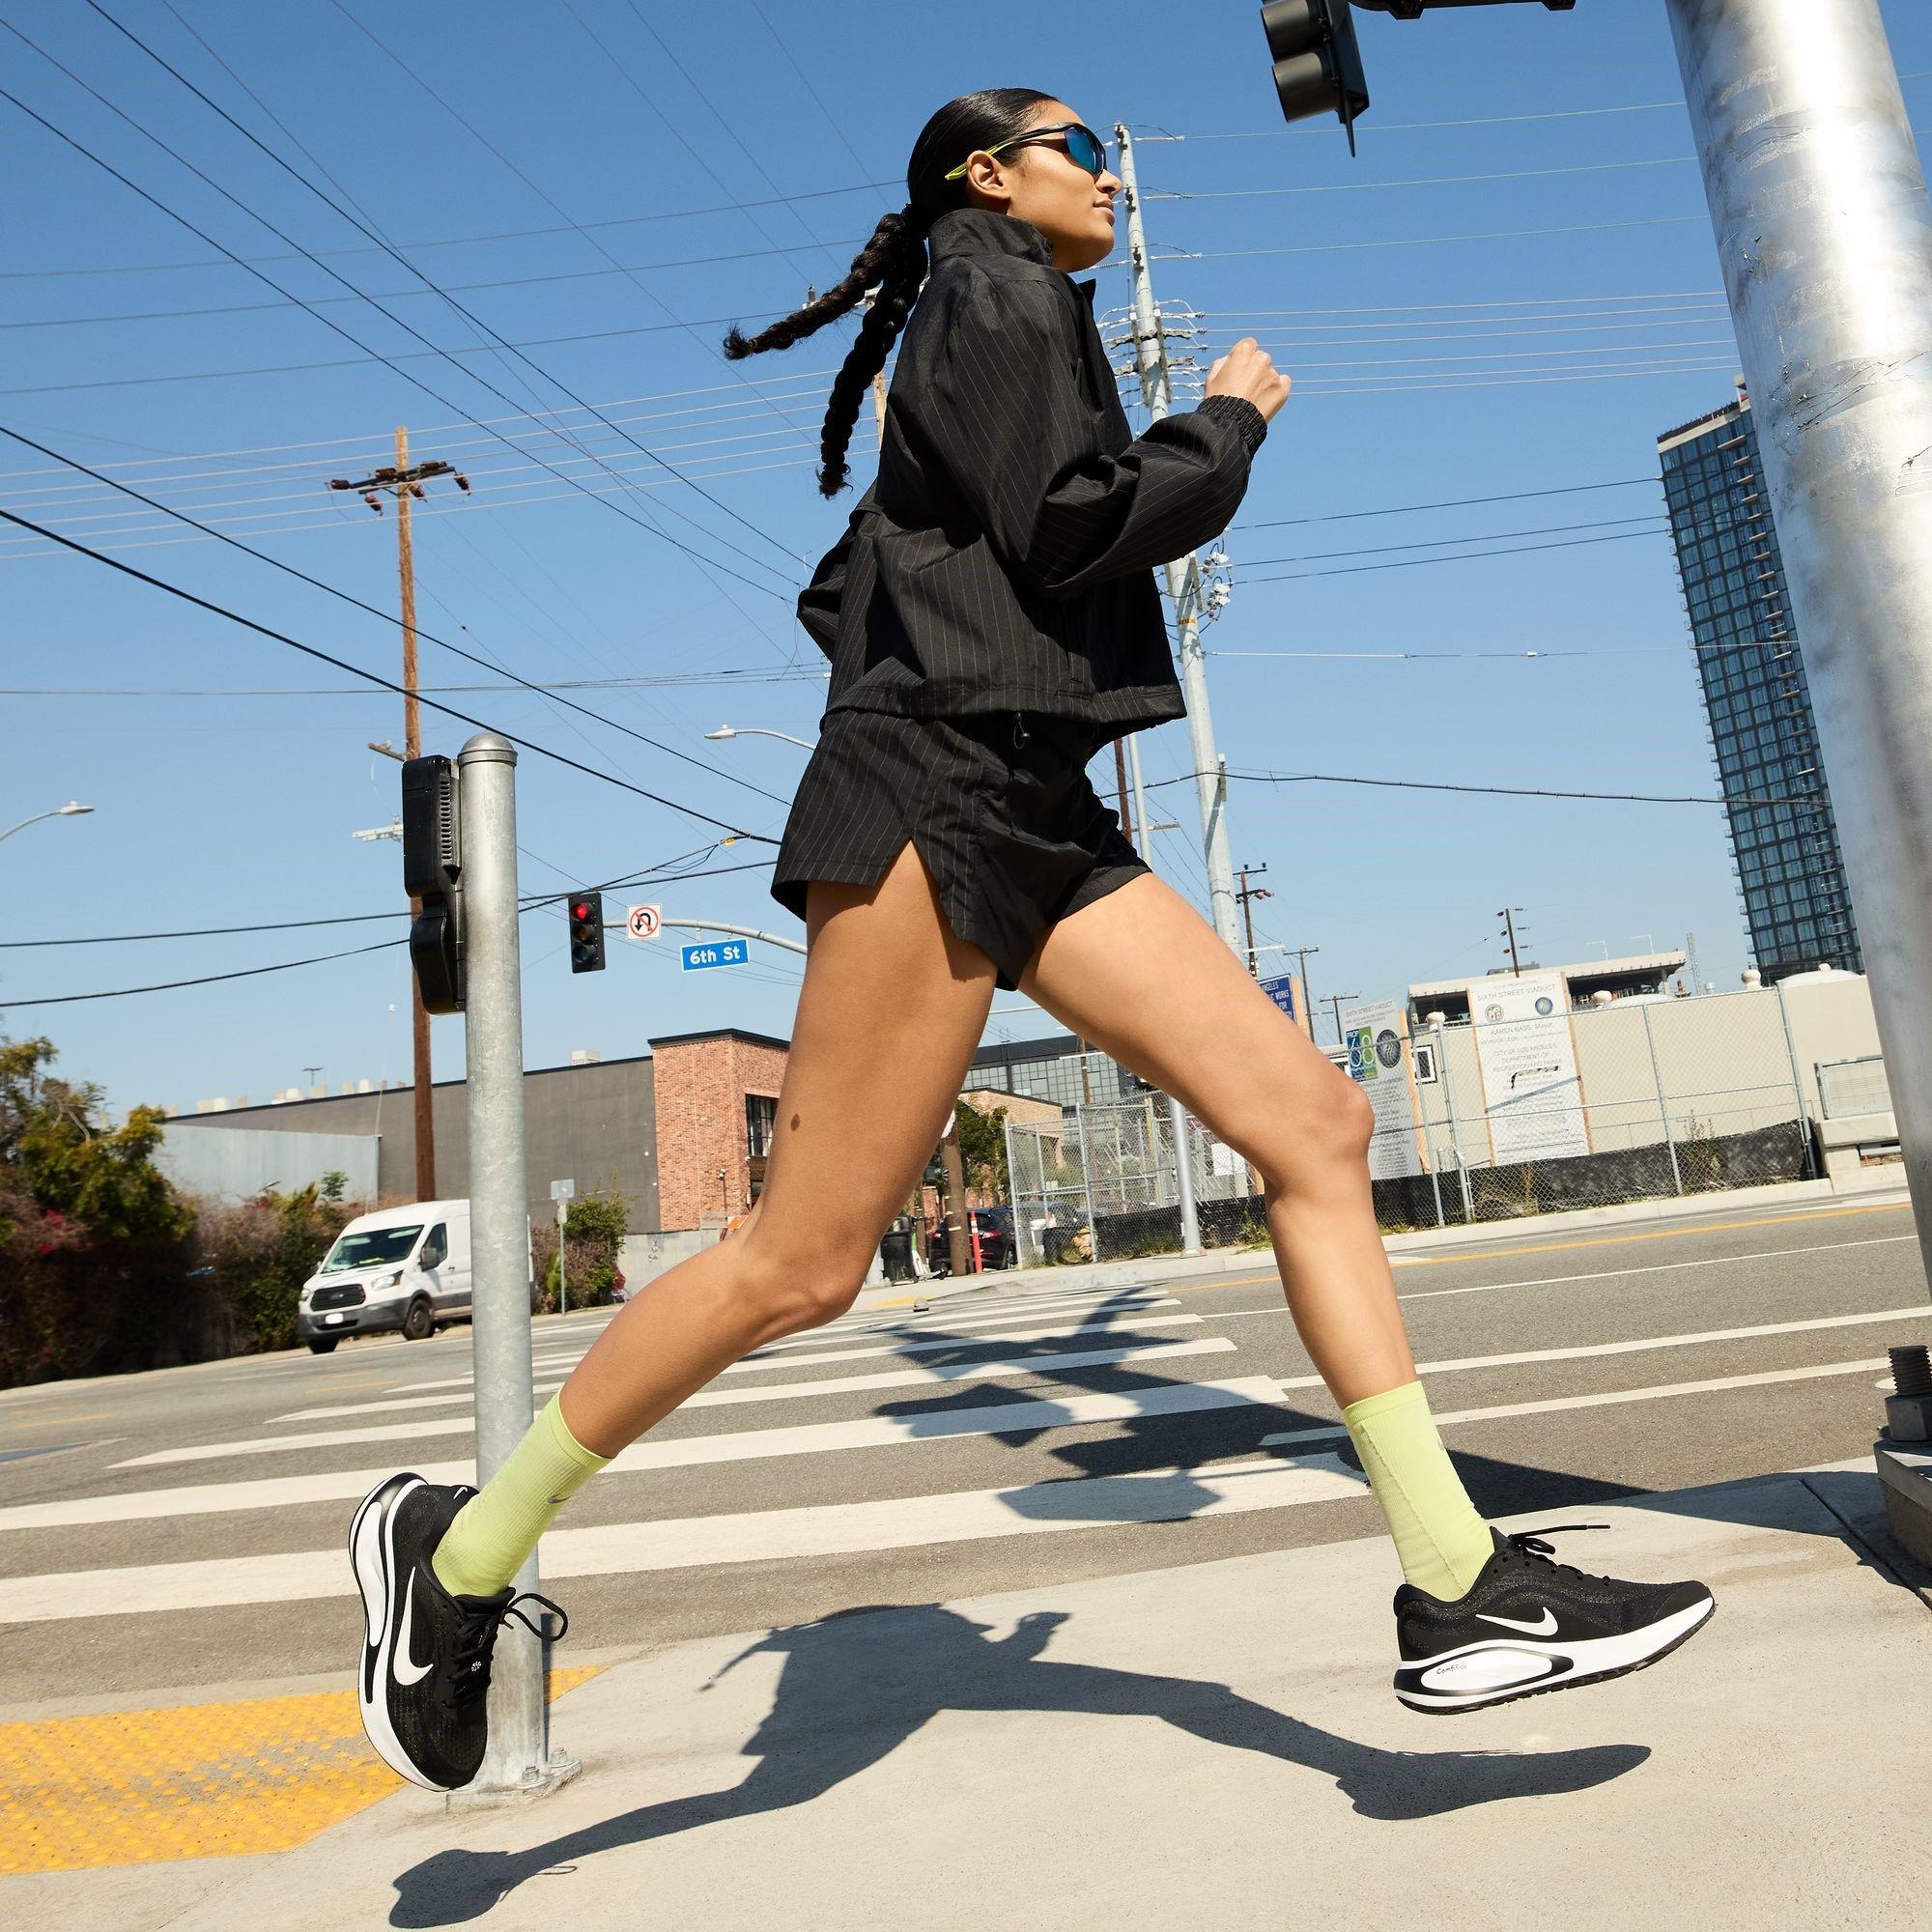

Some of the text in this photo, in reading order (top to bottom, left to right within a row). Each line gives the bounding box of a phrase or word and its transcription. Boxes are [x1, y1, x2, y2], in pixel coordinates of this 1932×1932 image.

[690, 946, 741, 965] 6th St
[1275, 990, 1290, 1000] WORKS
[1498, 987, 1525, 999] STREET
[1526, 983, 1556, 994] VIADUCT
[1358, 1006, 1375, 1015] STREET
[1375, 1001, 1393, 1011] VIADUCT
